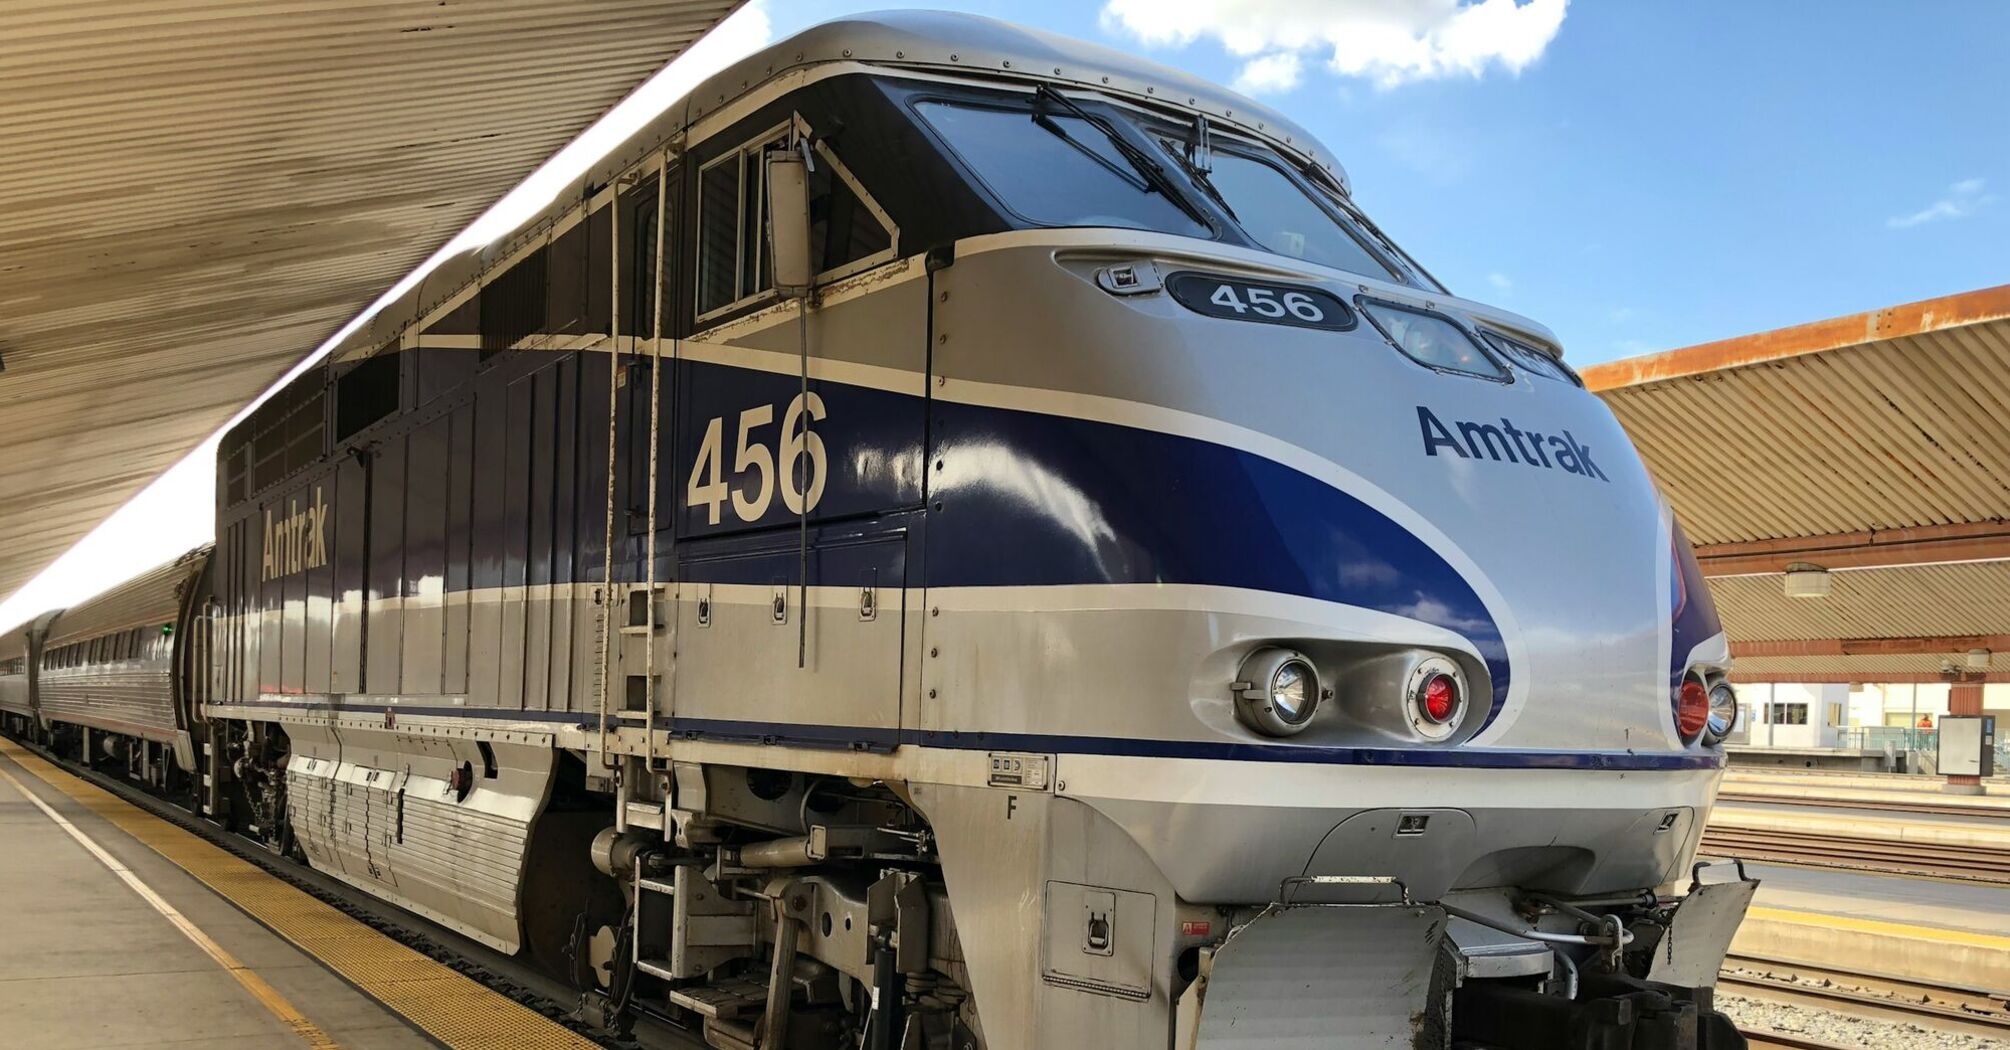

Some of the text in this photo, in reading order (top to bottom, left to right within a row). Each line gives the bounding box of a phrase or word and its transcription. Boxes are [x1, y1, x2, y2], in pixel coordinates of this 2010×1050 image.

[1210, 284, 1324, 322] 456
[687, 391, 828, 526] 456
[1416, 406, 1610, 483] Amtrak
[262, 486, 328, 583] Amtrak
[1007, 795, 1017, 820] F
